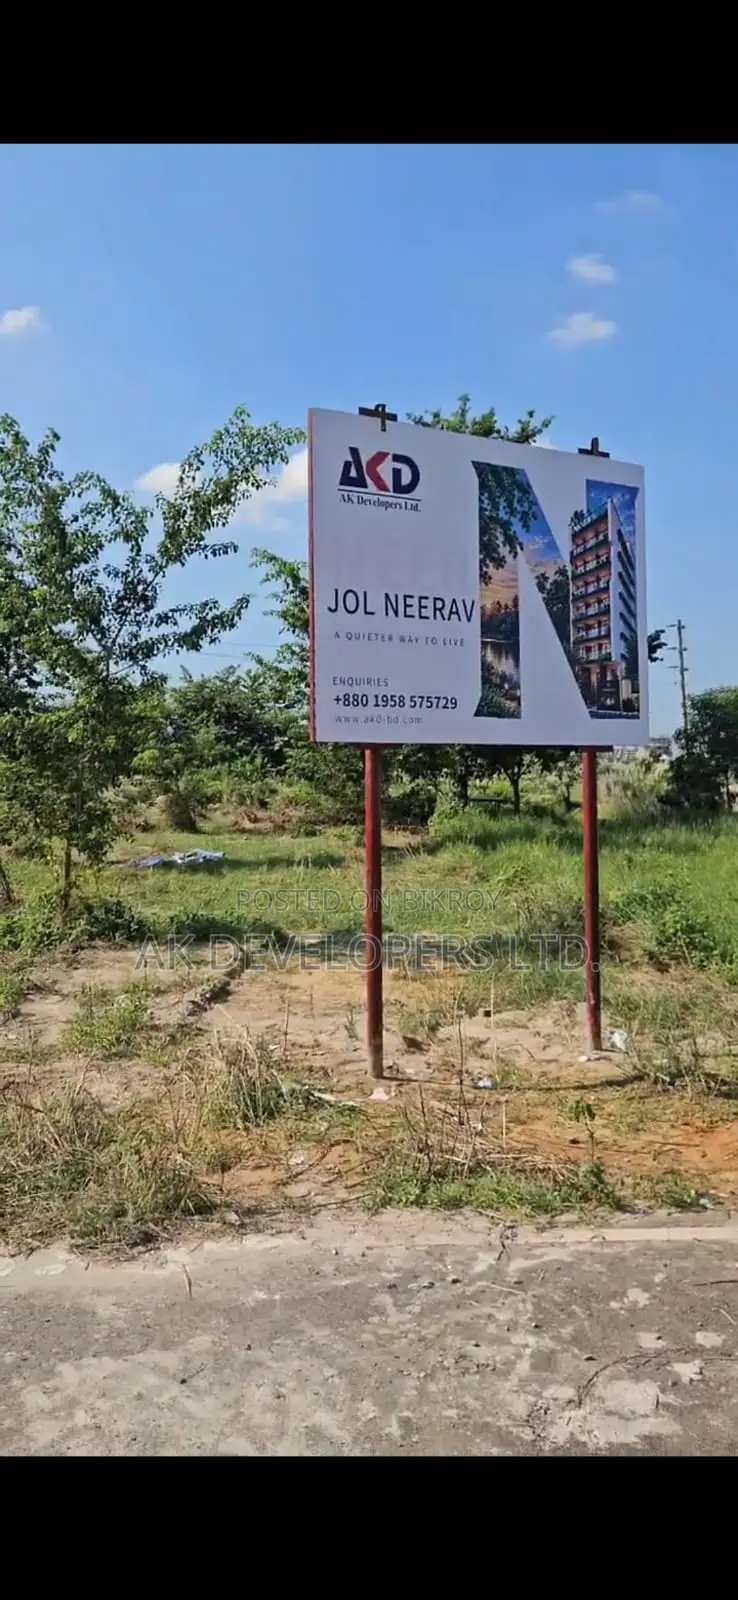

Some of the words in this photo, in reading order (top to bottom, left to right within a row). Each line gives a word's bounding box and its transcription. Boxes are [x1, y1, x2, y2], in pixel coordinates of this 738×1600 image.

[339, 493, 354, 504] AK
[357, 495, 402, 511] Developers
[404, 502, 422, 512] Ltd.
[327, 588, 376, 616] JOL
[384, 592, 476, 623] NEERAV
[334, 631, 341, 640] A
[345, 632, 394, 643] QUIETER
[399, 635, 420, 645] WAY
[425, 636, 438, 646] TO
[443, 638, 465, 647] LIVE
[332, 676, 390, 687] ENQUIRIES
[333, 692, 369, 708] +880
[373, 693, 406, 708] 1958
[409, 695, 458, 710] 575729
[334, 714, 423, 725] www.akd-bd.com
